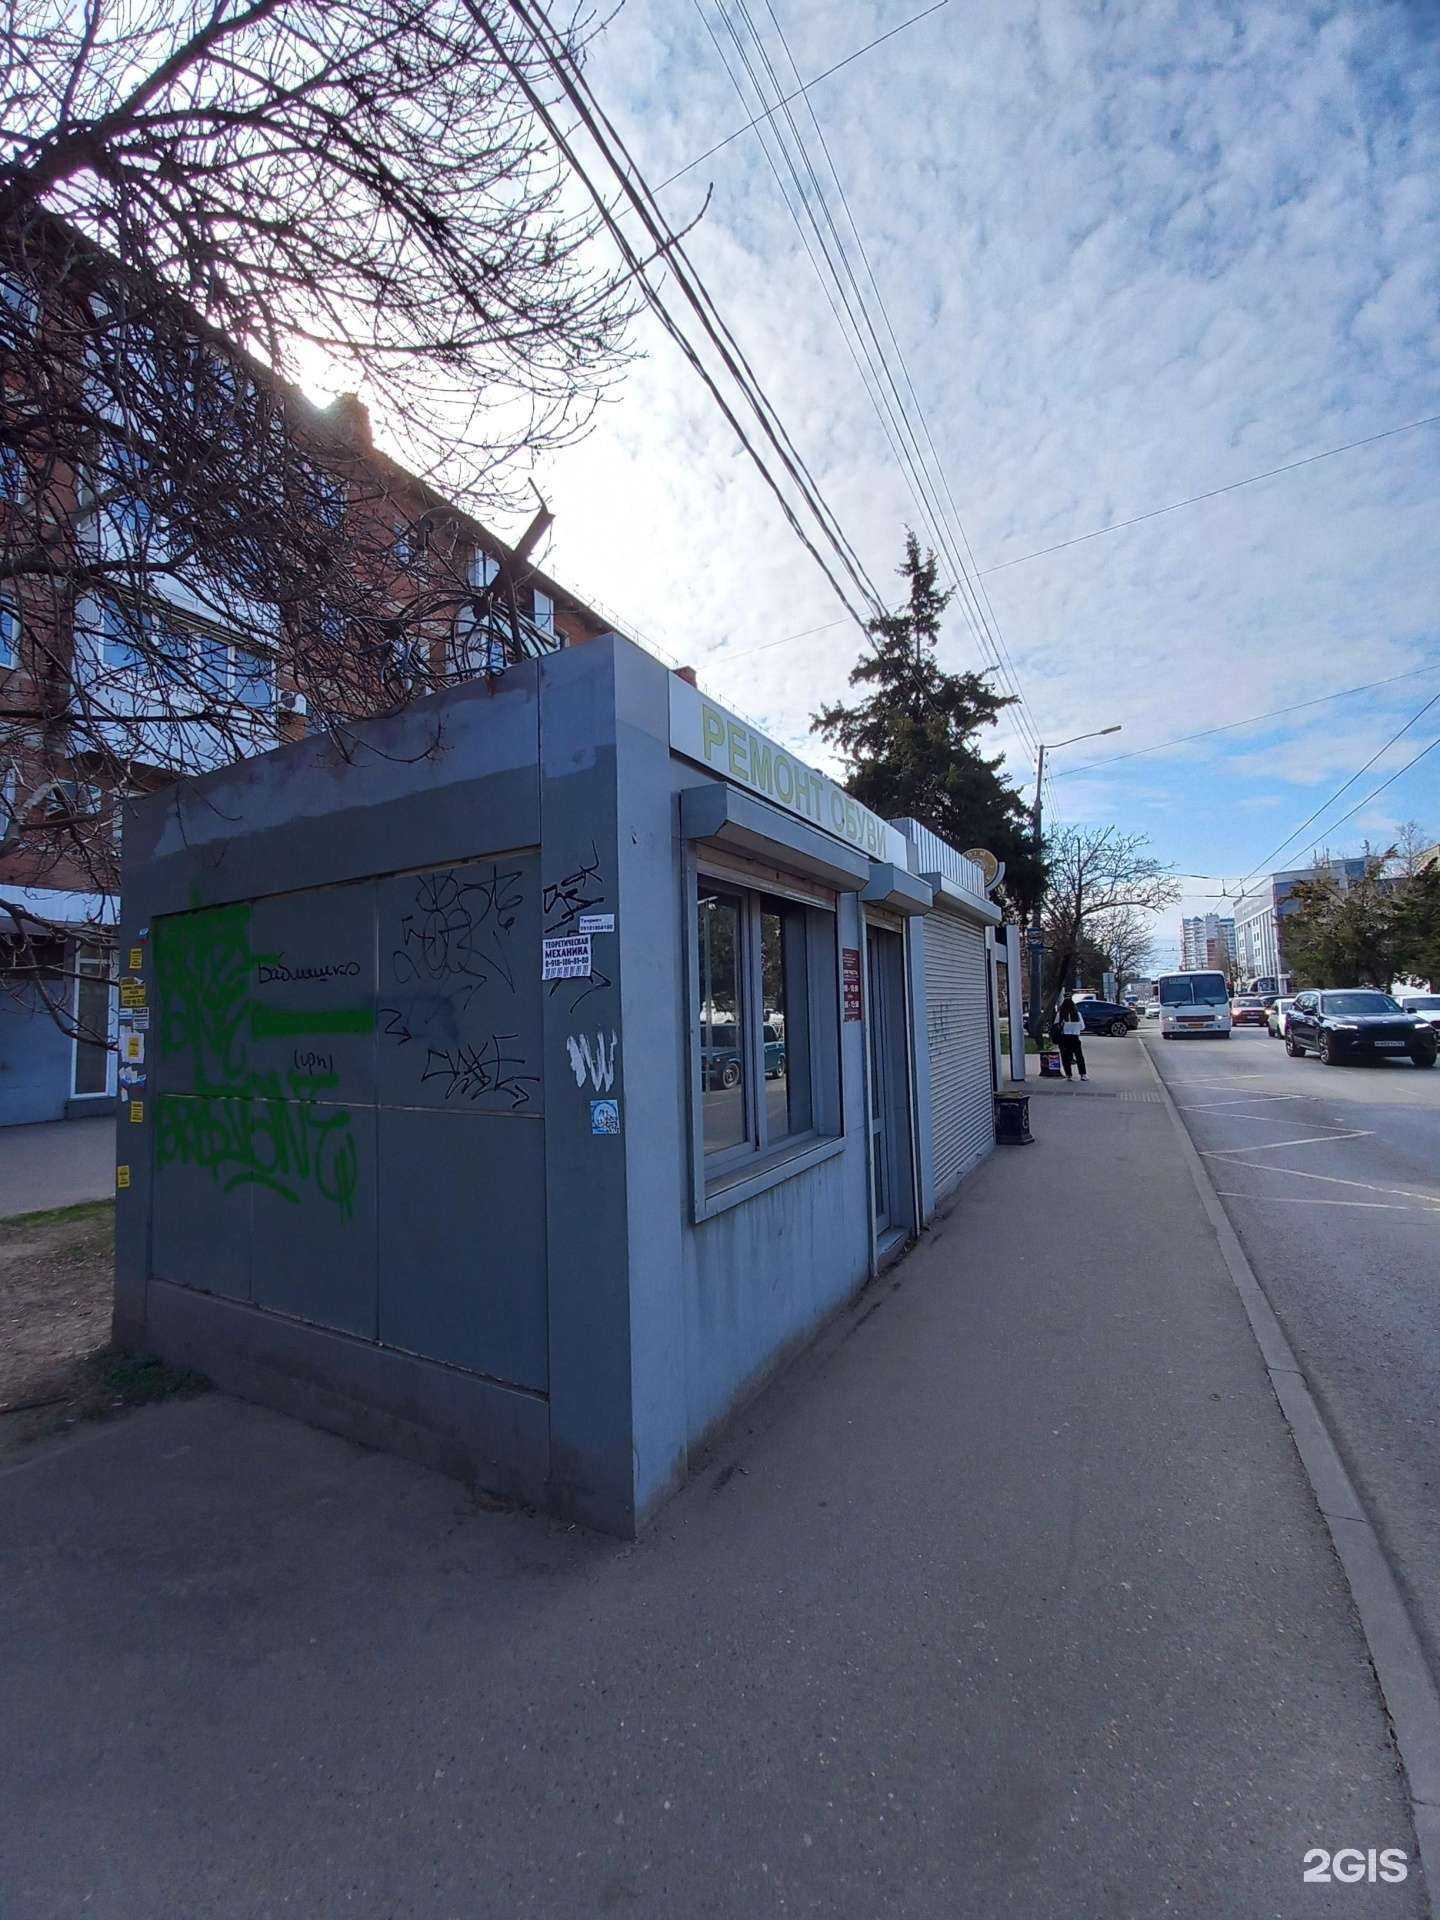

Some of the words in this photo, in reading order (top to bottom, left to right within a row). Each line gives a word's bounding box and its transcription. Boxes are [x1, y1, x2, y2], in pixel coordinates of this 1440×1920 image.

[702, 703, 823, 821] РЕМОНТ
[831, 790, 887, 859] ОБУВИ
[545, 937, 589, 949] ТЕОРЕТИЧЕСКАЯ
[545, 946, 588, 959] МЕХАНИКА
